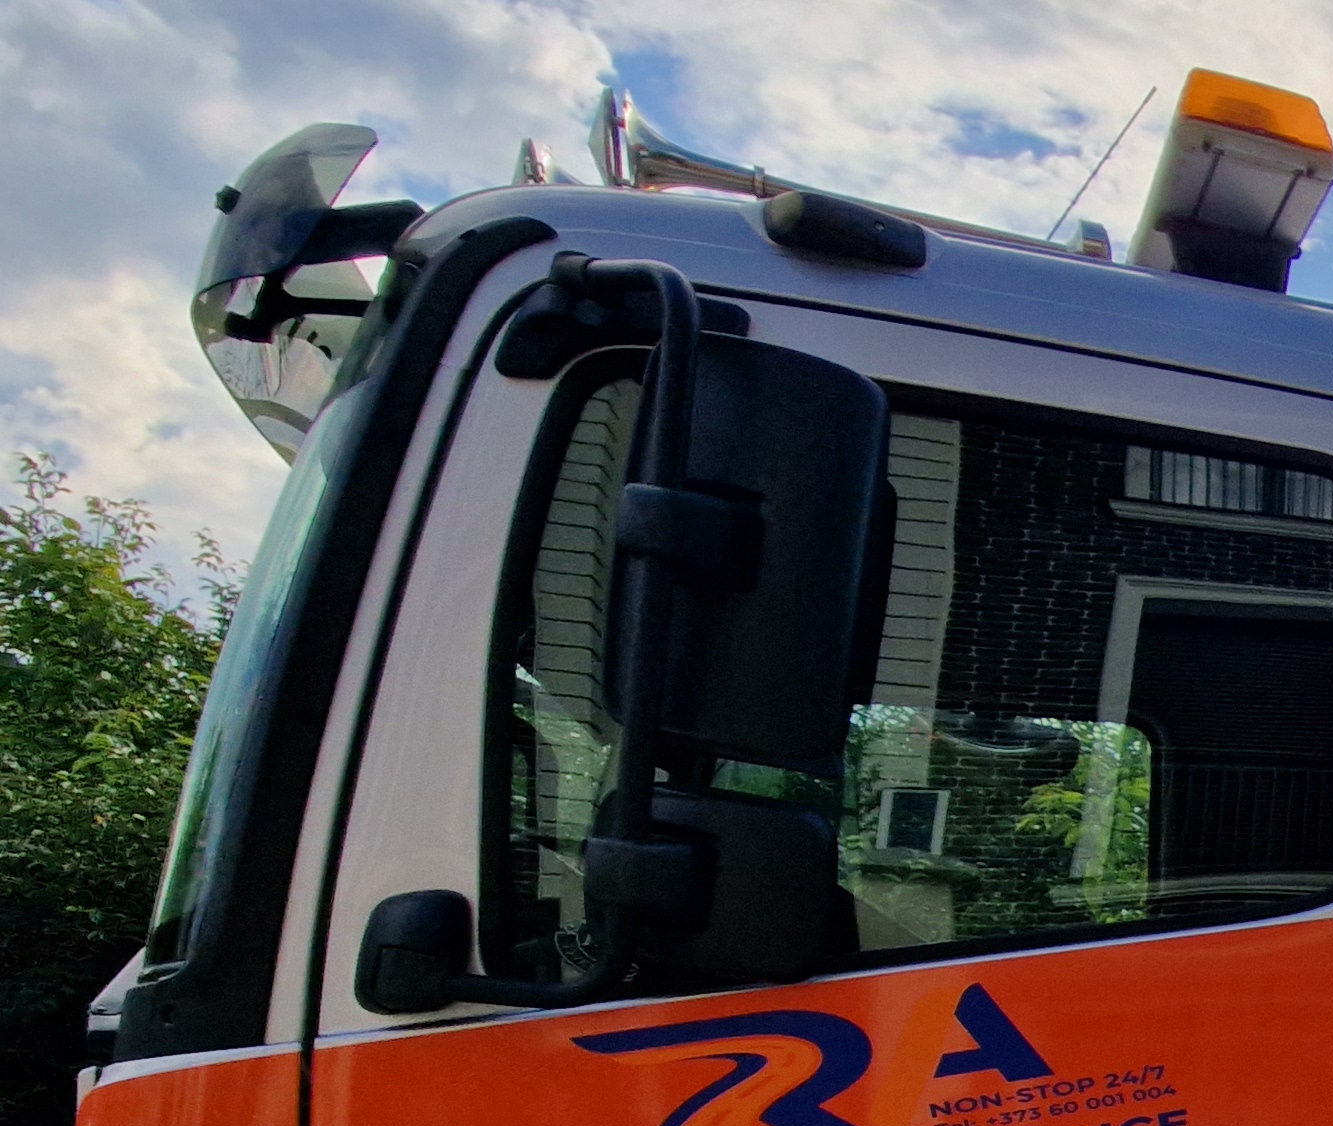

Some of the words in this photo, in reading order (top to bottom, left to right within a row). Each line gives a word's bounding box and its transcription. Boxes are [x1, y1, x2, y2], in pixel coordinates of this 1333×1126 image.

[929, 1076, 1095, 1118] NON-STOP
[1103, 1064, 1165, 1089] 24/7
[986, 1107, 1042, 1126] +373
[1049, 1101, 1079, 1116] 60
[1086, 1092, 1126, 1110] 001
[1132, 1084, 1178, 1101] 004
